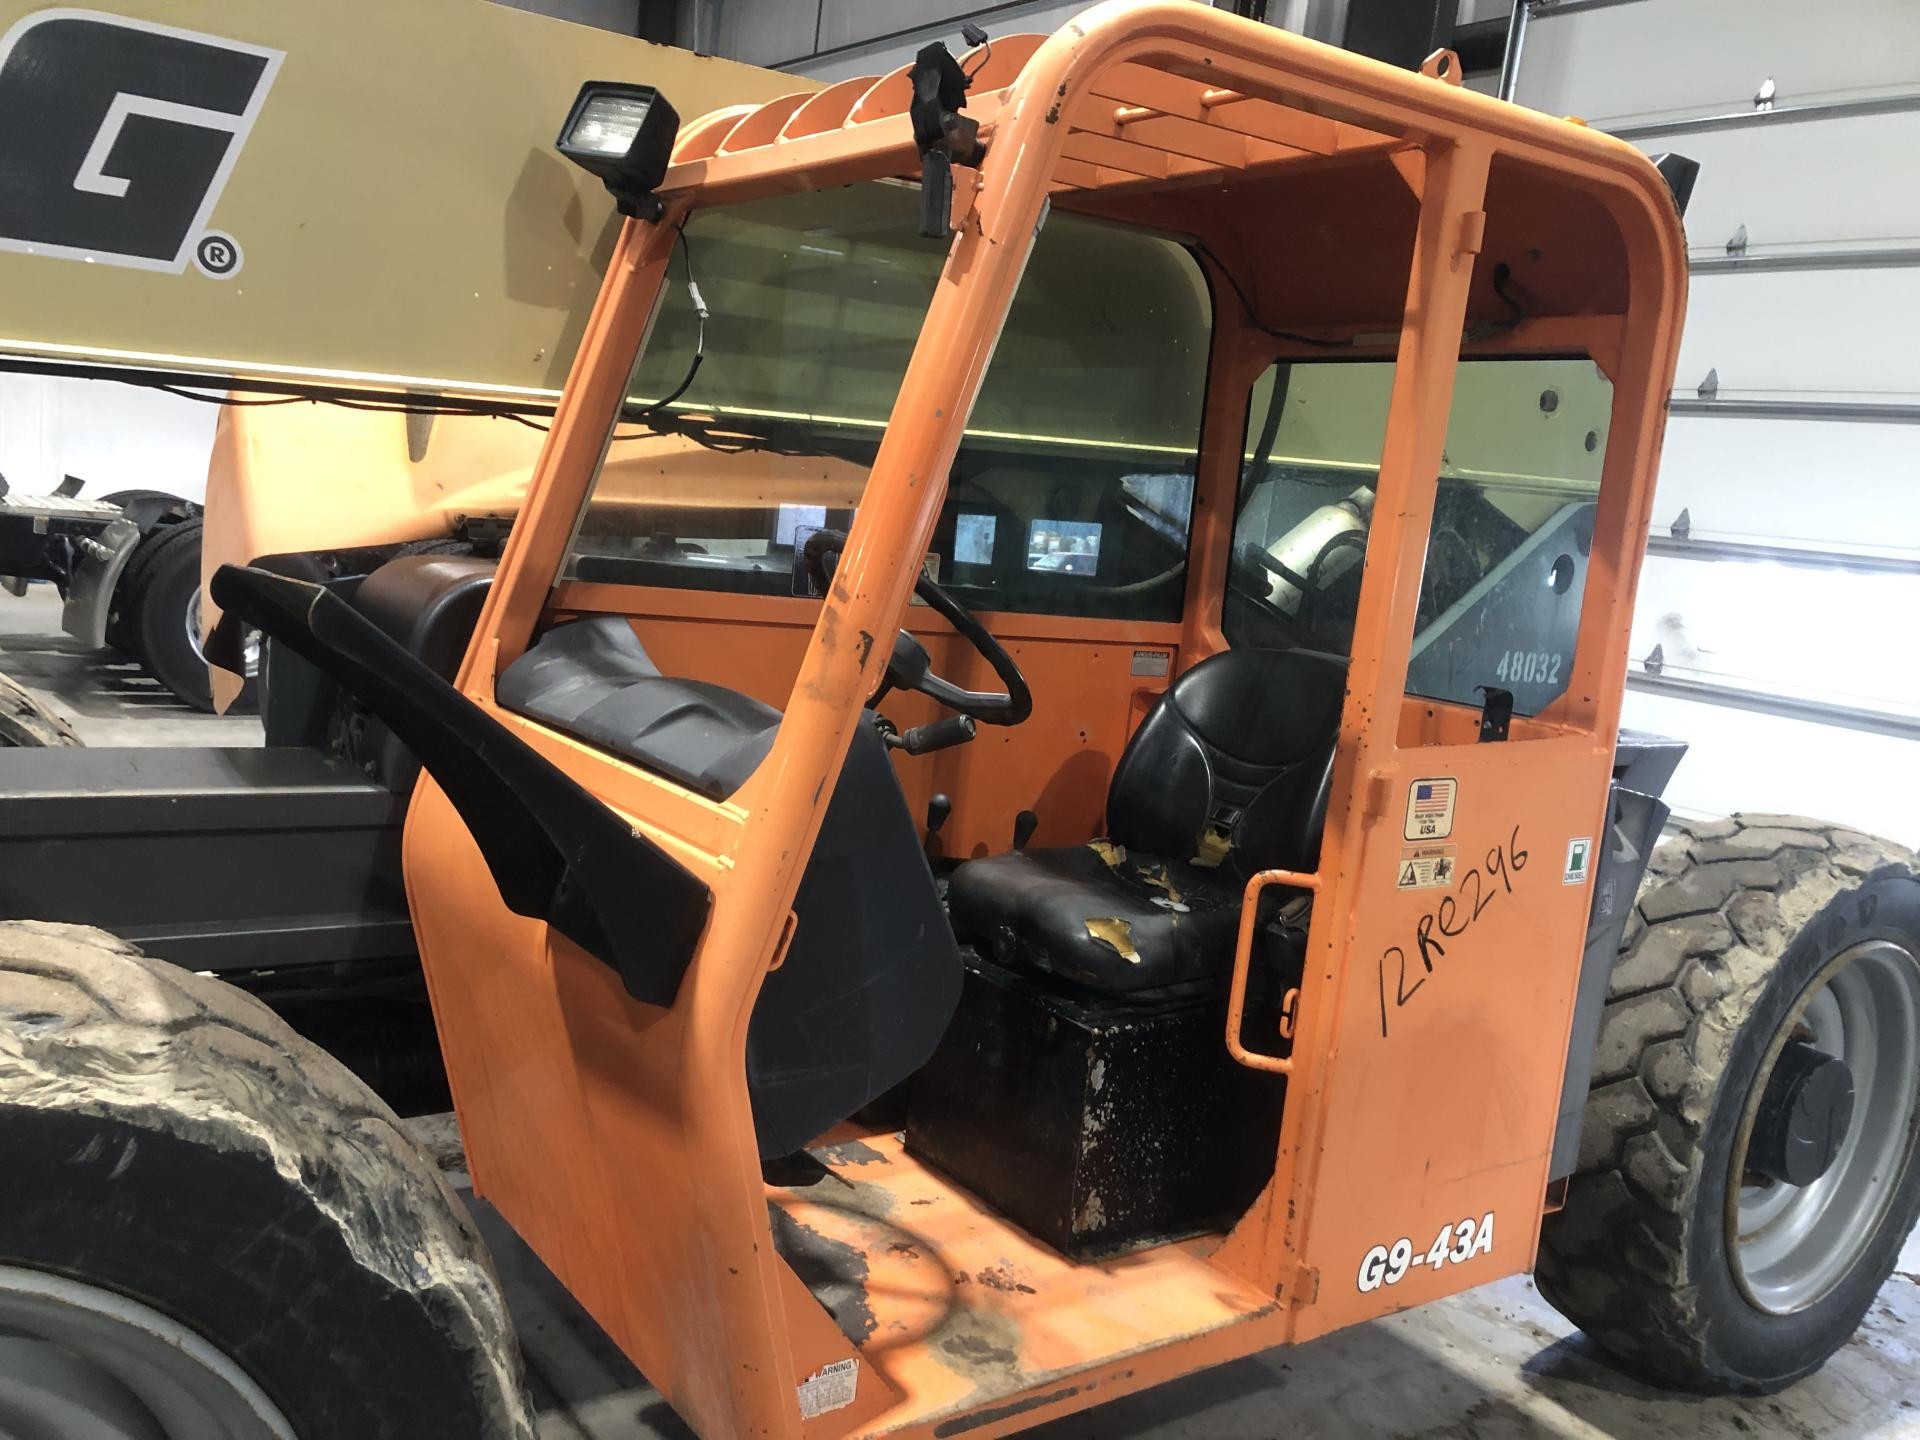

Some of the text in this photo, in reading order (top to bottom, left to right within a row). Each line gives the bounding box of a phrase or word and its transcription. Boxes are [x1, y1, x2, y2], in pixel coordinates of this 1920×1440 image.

[1496, 650, 1562, 684] 48032
[1420, 825, 1436, 835] USA
[1564, 871, 1585, 880] DIESEL
[1357, 1211, 1495, 1294] G9-43A
[815, 1362, 852, 1377] ARNING
